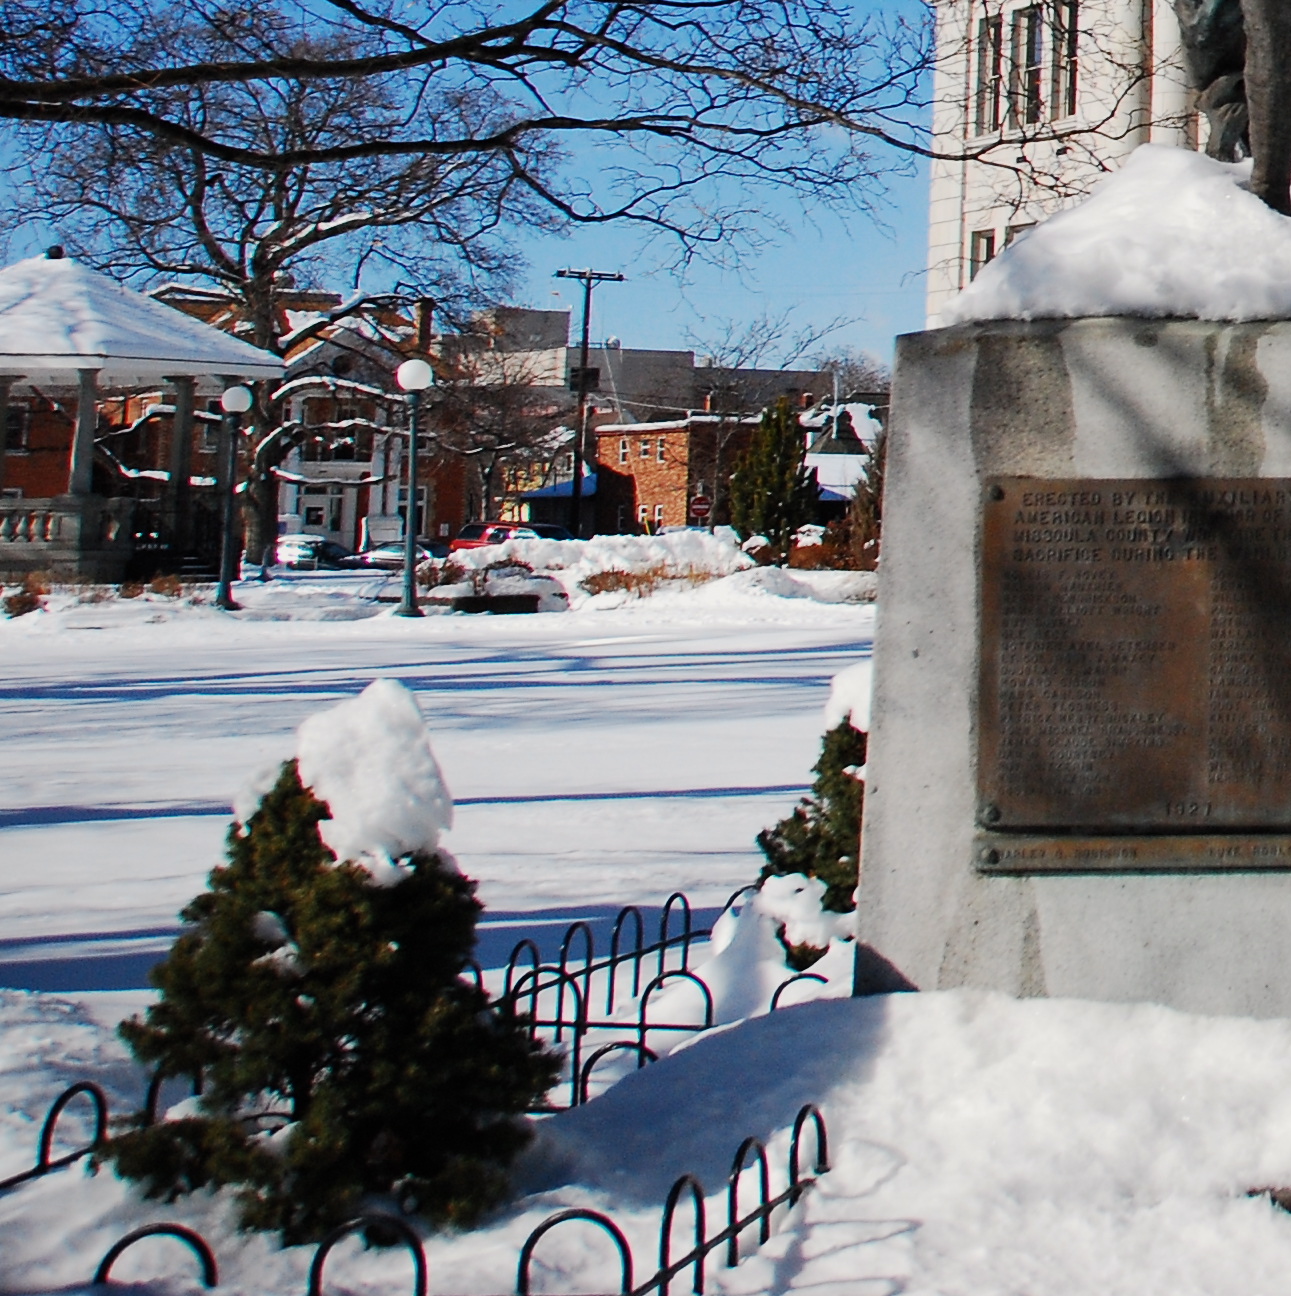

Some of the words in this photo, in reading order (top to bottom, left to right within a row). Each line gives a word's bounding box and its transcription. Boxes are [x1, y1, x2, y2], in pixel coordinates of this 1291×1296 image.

[1023, 492, 1100, 506] ERECTED
[1112, 492, 1135, 506] BY
[1014, 510, 1105, 524] AMERICAN
[1113, 509, 1175, 524] LEGION
[1263, 508, 1284, 522] OF
[1013, 528, 1100, 543] MISSOULA
[1106, 527, 1174, 542] COUNTY
[1013, 548, 1101, 562] SACRIFICE
[1112, 547, 1175, 562] DURING
[1186, 547, 1218, 561] THE
